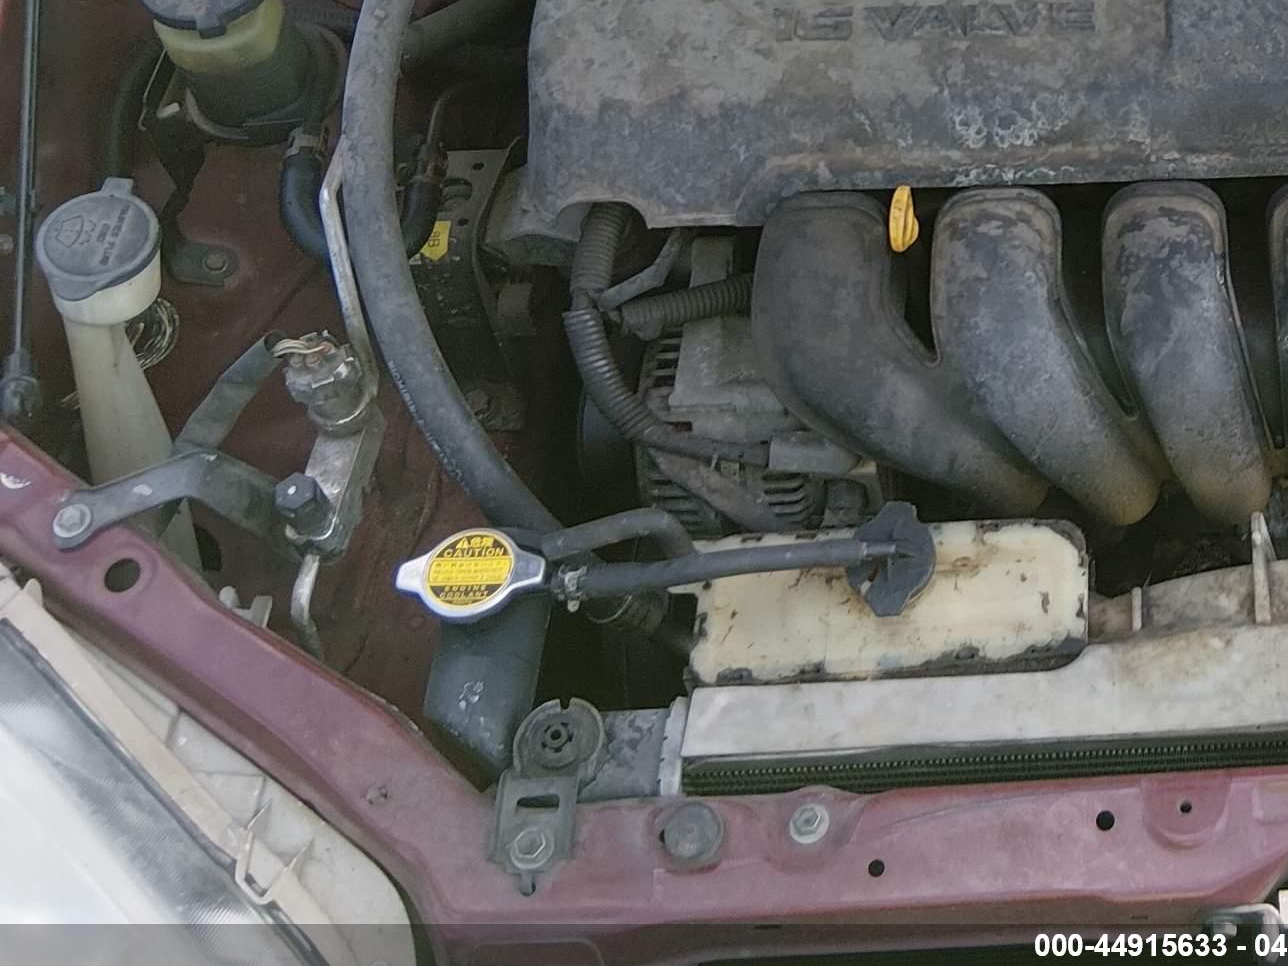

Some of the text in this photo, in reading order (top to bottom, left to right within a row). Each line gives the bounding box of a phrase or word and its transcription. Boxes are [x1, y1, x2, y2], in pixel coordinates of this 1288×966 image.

[773, 0, 1096, 42] 16 VALVE
[443, 546, 505, 559] CAUTION
[444, 584, 487, 593] ENGINE
[439, 590, 489, 600] COOLANT
